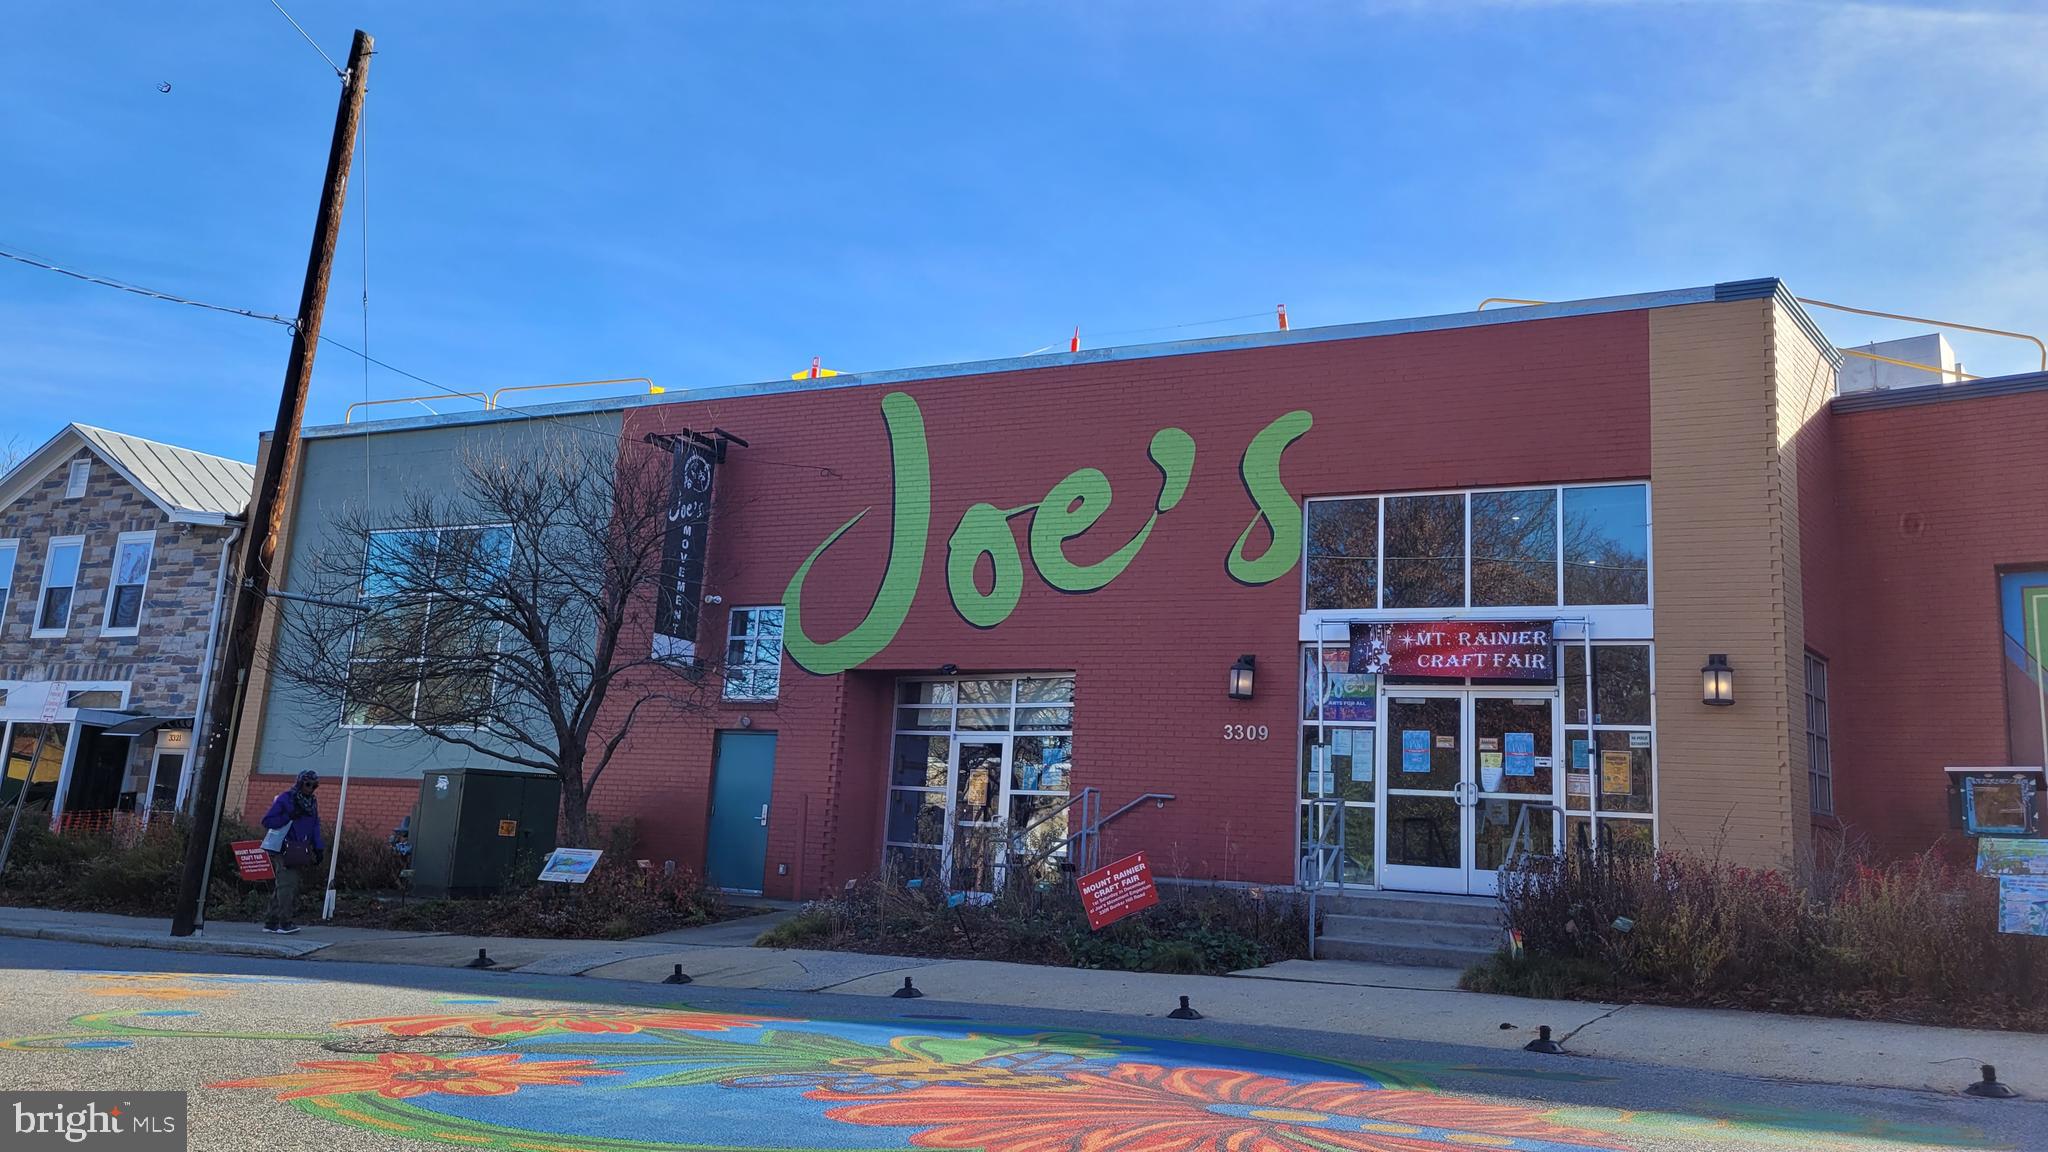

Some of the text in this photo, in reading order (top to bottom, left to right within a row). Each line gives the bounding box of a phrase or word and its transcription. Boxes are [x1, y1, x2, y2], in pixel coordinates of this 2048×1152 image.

[668, 490, 704, 521] Joe's
[782, 392, 1313, 677] Joe's
[672, 525, 692, 634] MOVEMENT
[1417, 630, 1547, 646] MT. RAINIER
[1417, 652, 1546, 669] CRAFT FAIR
[1223, 724, 1269, 741] 3309
[1082, 863, 1146, 895] MOUNT RAINIER
[1094, 874, 1140, 898] CRAFT FAIR
